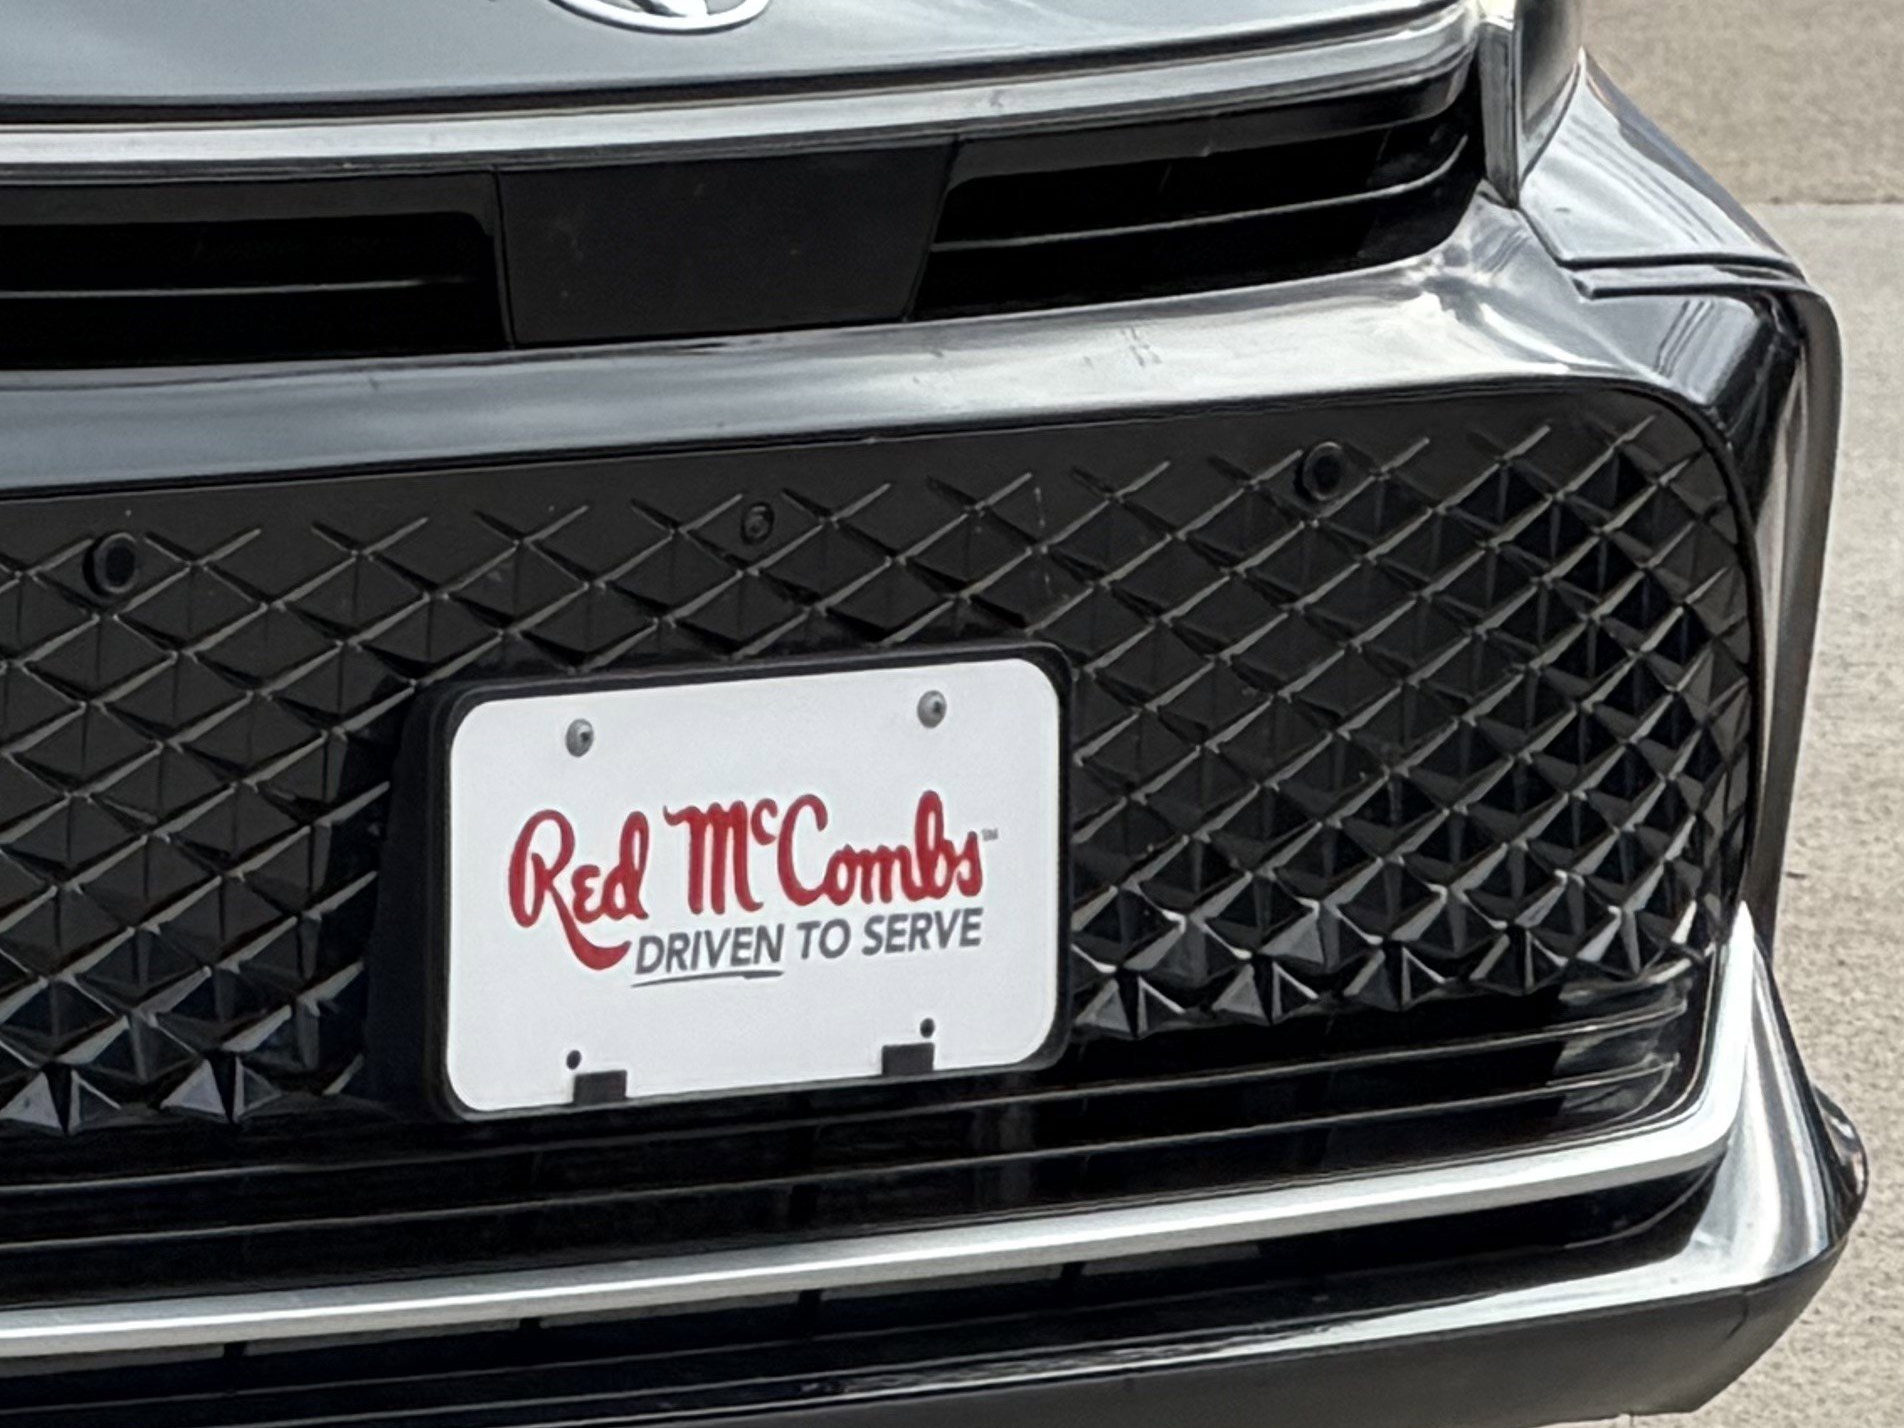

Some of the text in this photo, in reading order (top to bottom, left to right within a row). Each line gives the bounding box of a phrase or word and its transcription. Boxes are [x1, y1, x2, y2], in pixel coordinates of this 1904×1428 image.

[508, 809, 650, 970] Red
[635, 907, 984, 975] DRIVEN TO SERVE
